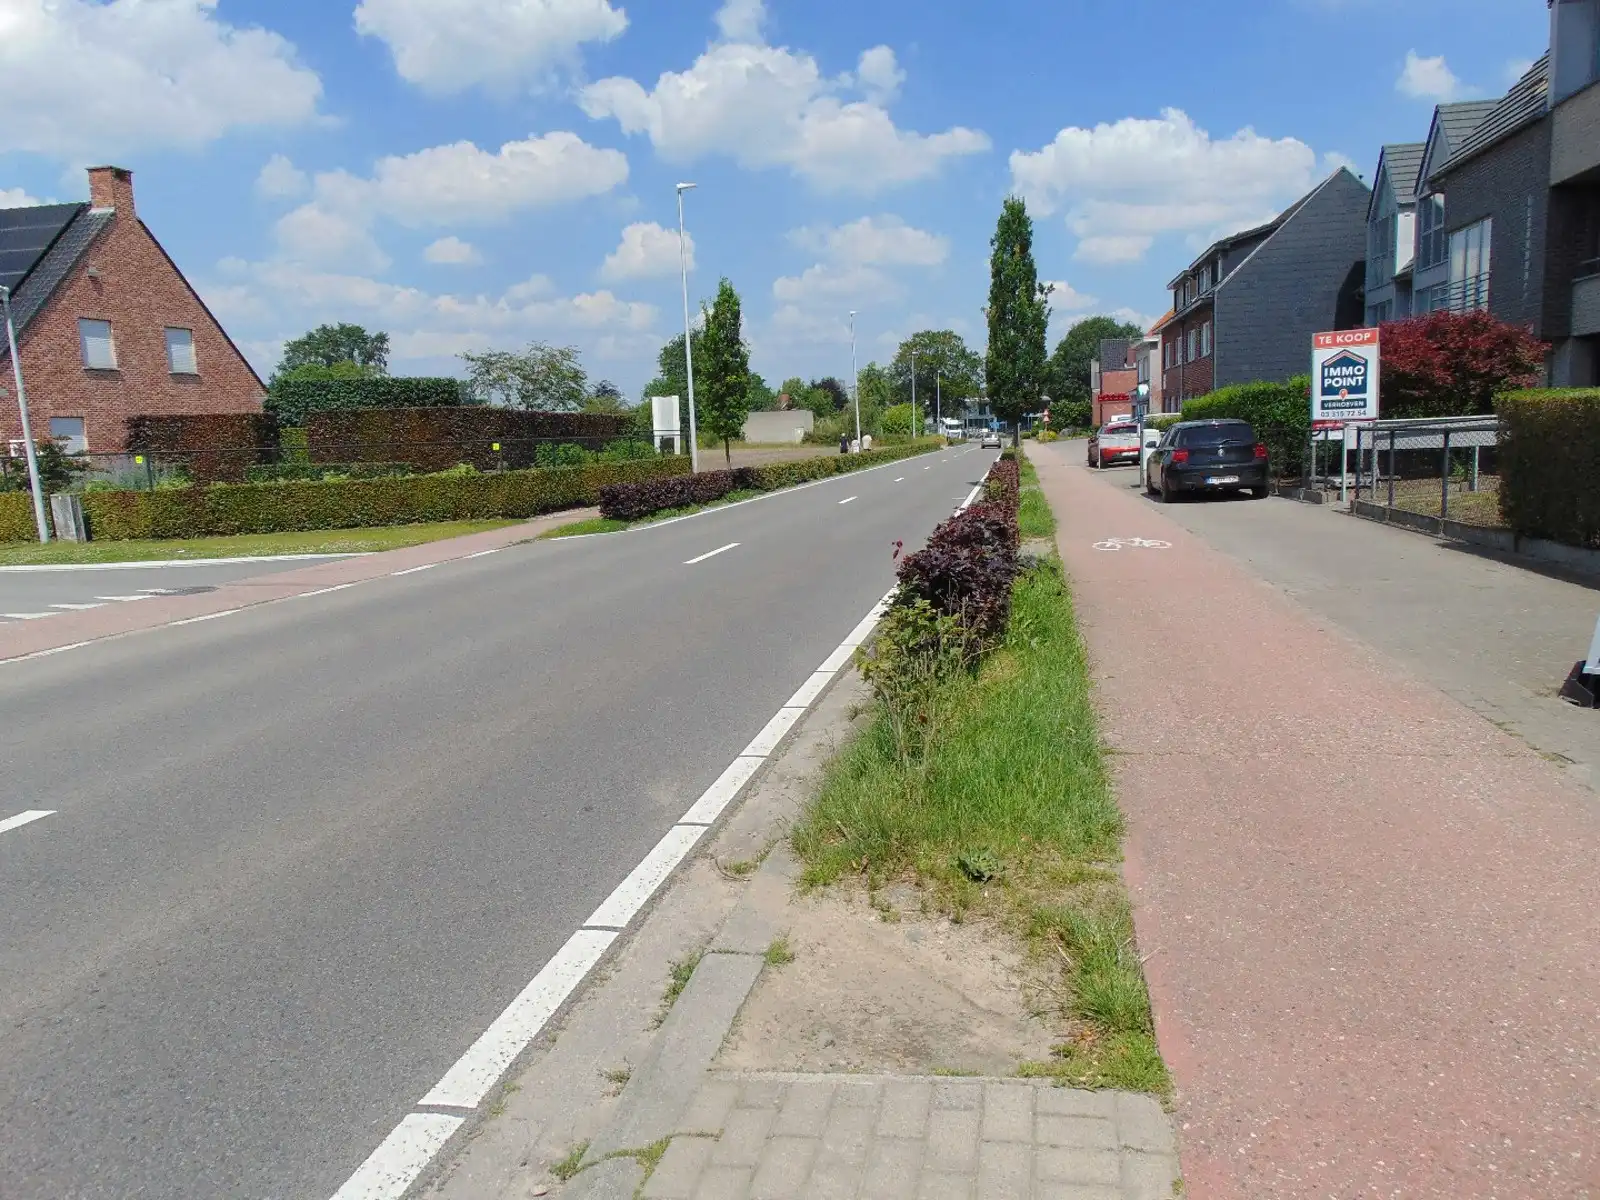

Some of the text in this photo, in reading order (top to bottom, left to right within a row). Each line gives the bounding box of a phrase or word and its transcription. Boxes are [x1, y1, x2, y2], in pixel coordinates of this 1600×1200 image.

[1319, 332, 1371, 344] TE KOOP
[1324, 365, 1365, 377] IMMO
[1324, 376, 1364, 387] POINT
